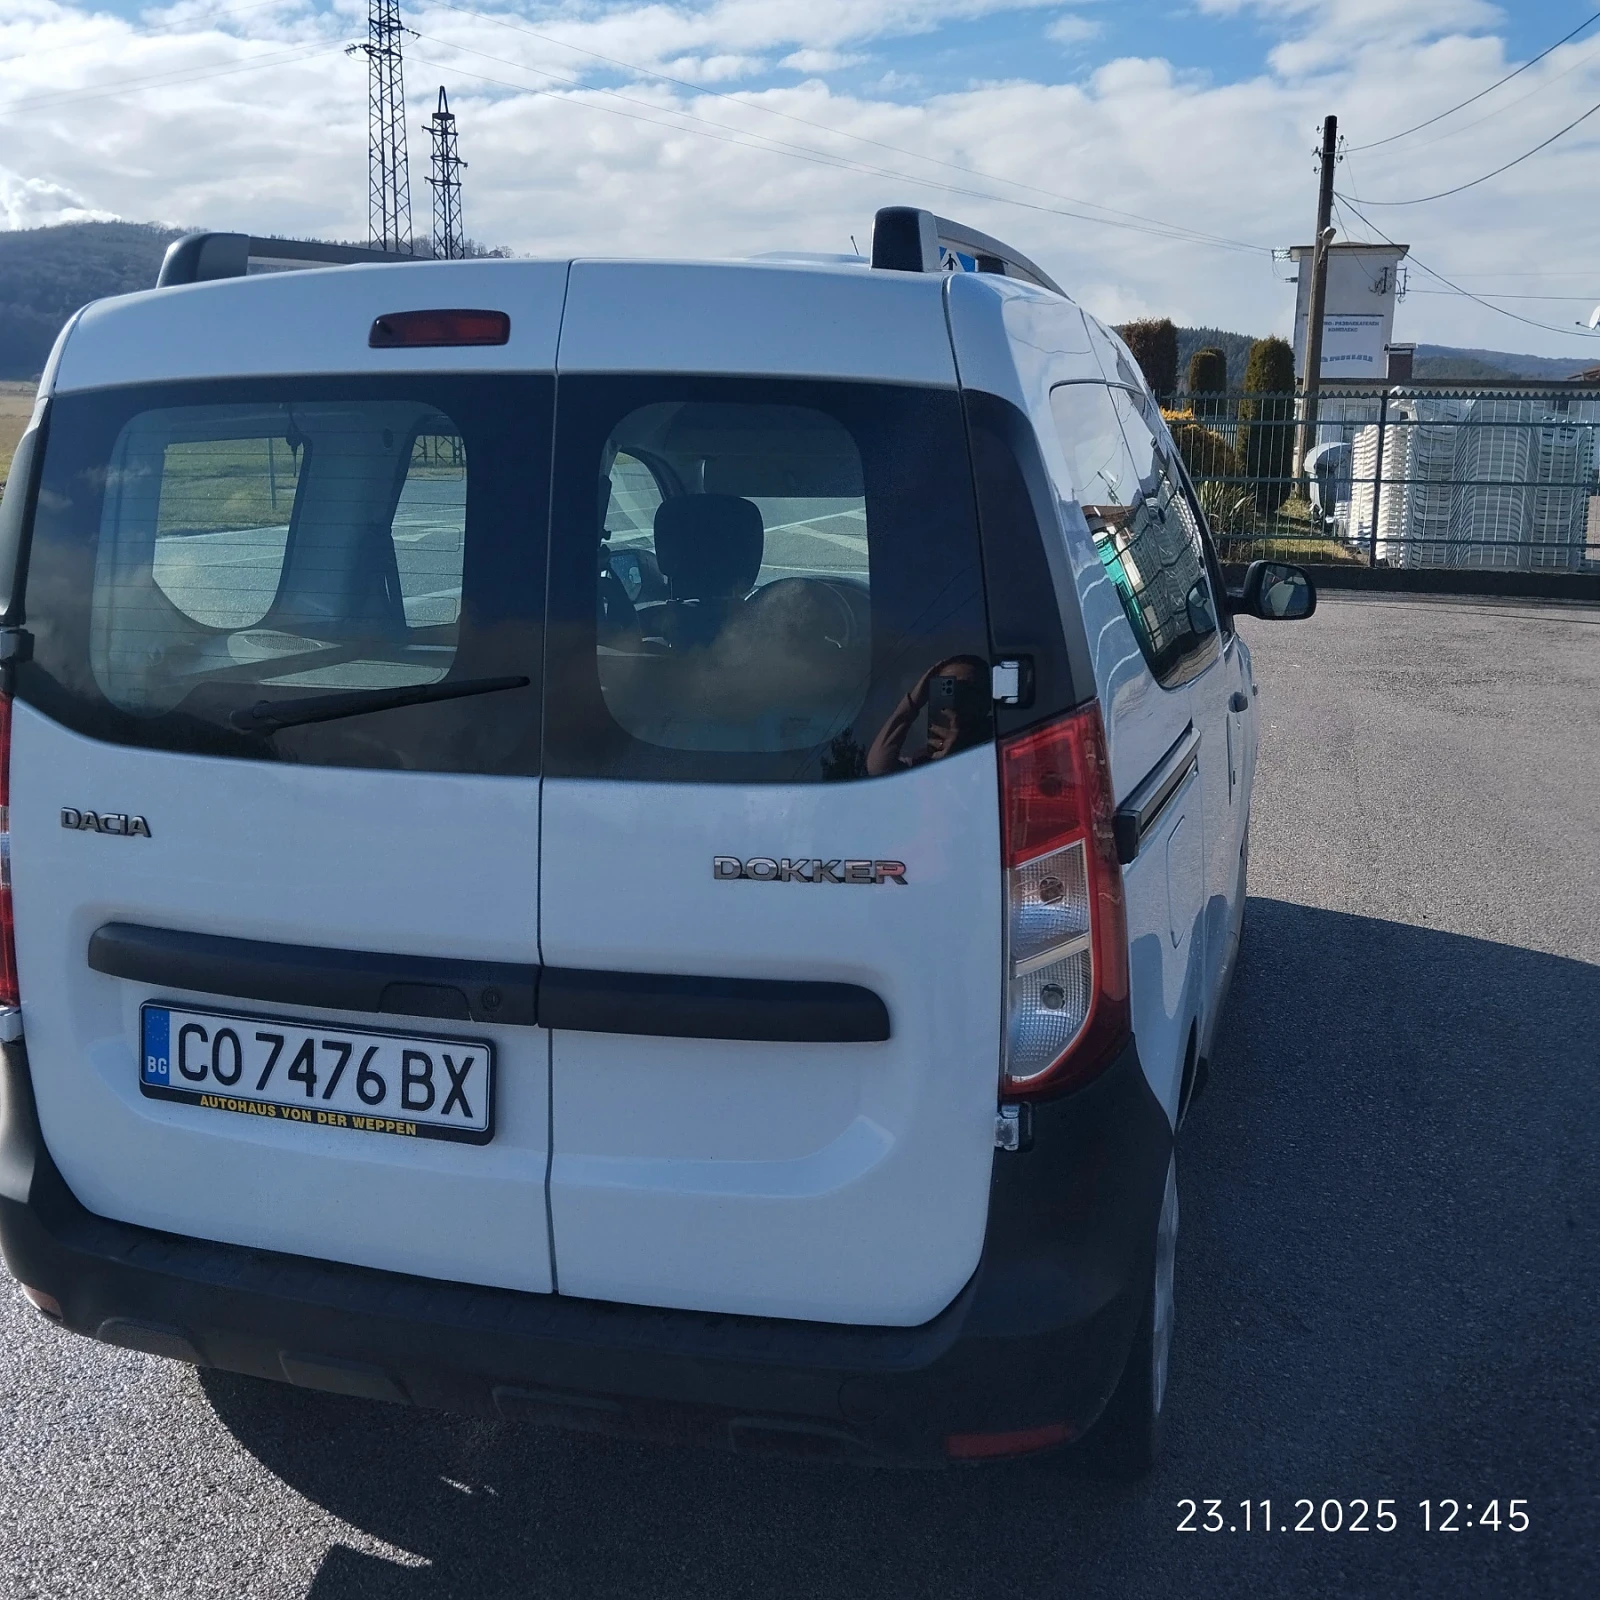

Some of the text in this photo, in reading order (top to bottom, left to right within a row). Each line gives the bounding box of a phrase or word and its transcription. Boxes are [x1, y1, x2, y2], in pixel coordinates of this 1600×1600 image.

[61, 806, 152, 838] DACIA
[713, 855, 908, 885] DOKKER
[147, 1055, 168, 1075] BG
[254, 1031, 387, 1106] 7476
[200, 1095, 417, 1135] AUTOHAUS VON DER WEPPEN
